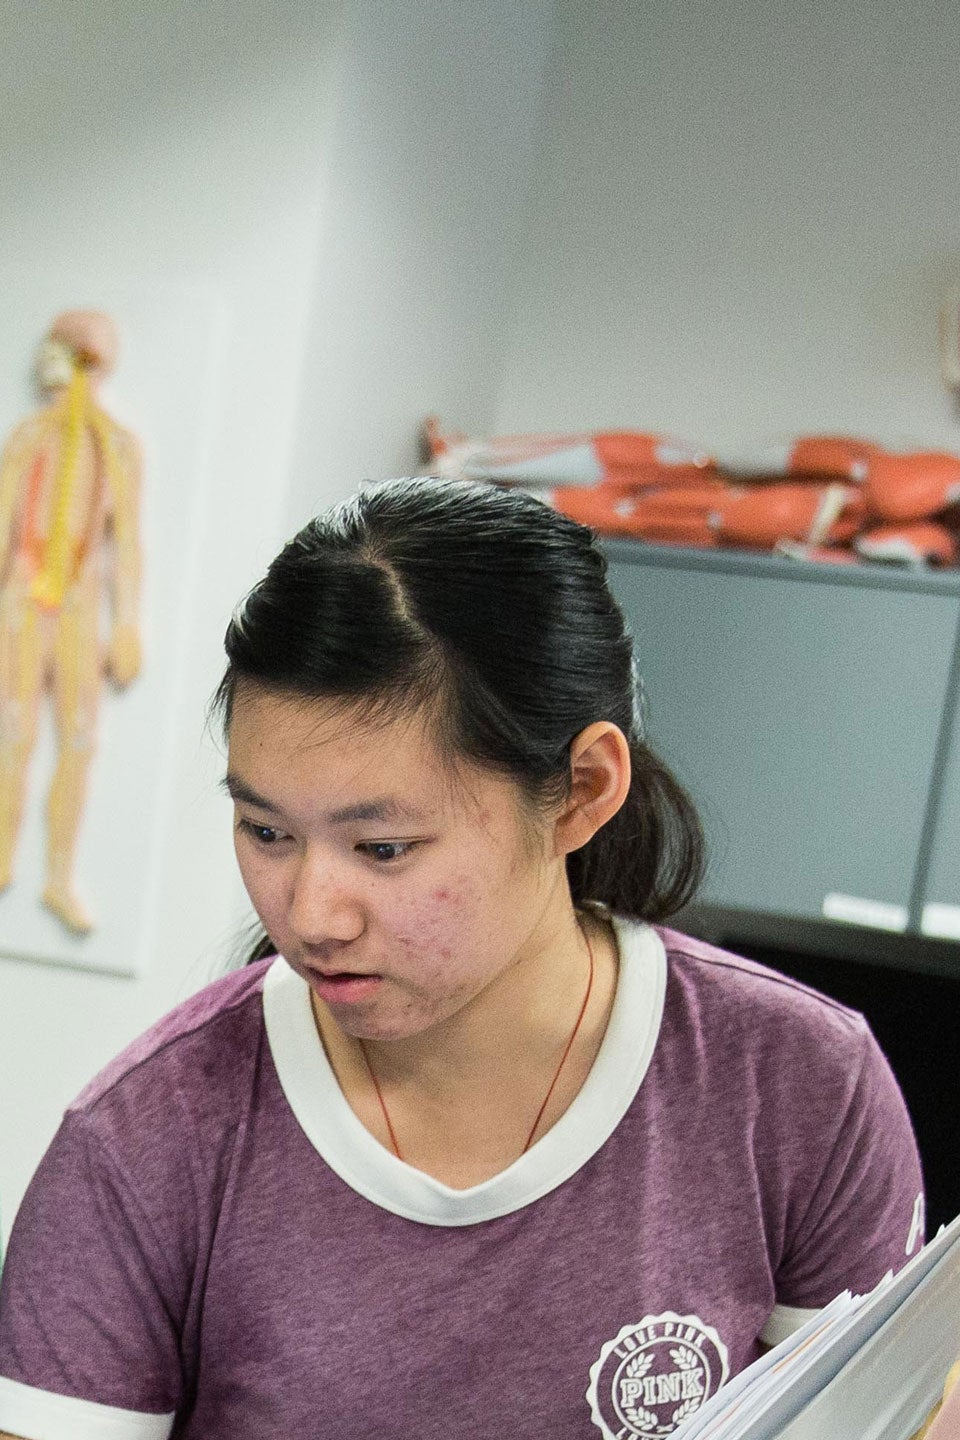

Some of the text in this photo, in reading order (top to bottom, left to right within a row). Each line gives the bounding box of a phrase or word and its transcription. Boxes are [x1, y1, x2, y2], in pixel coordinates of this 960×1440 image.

[613, 1321, 708, 1360] LOVE PINK
[620, 1366, 705, 1409] PINK
